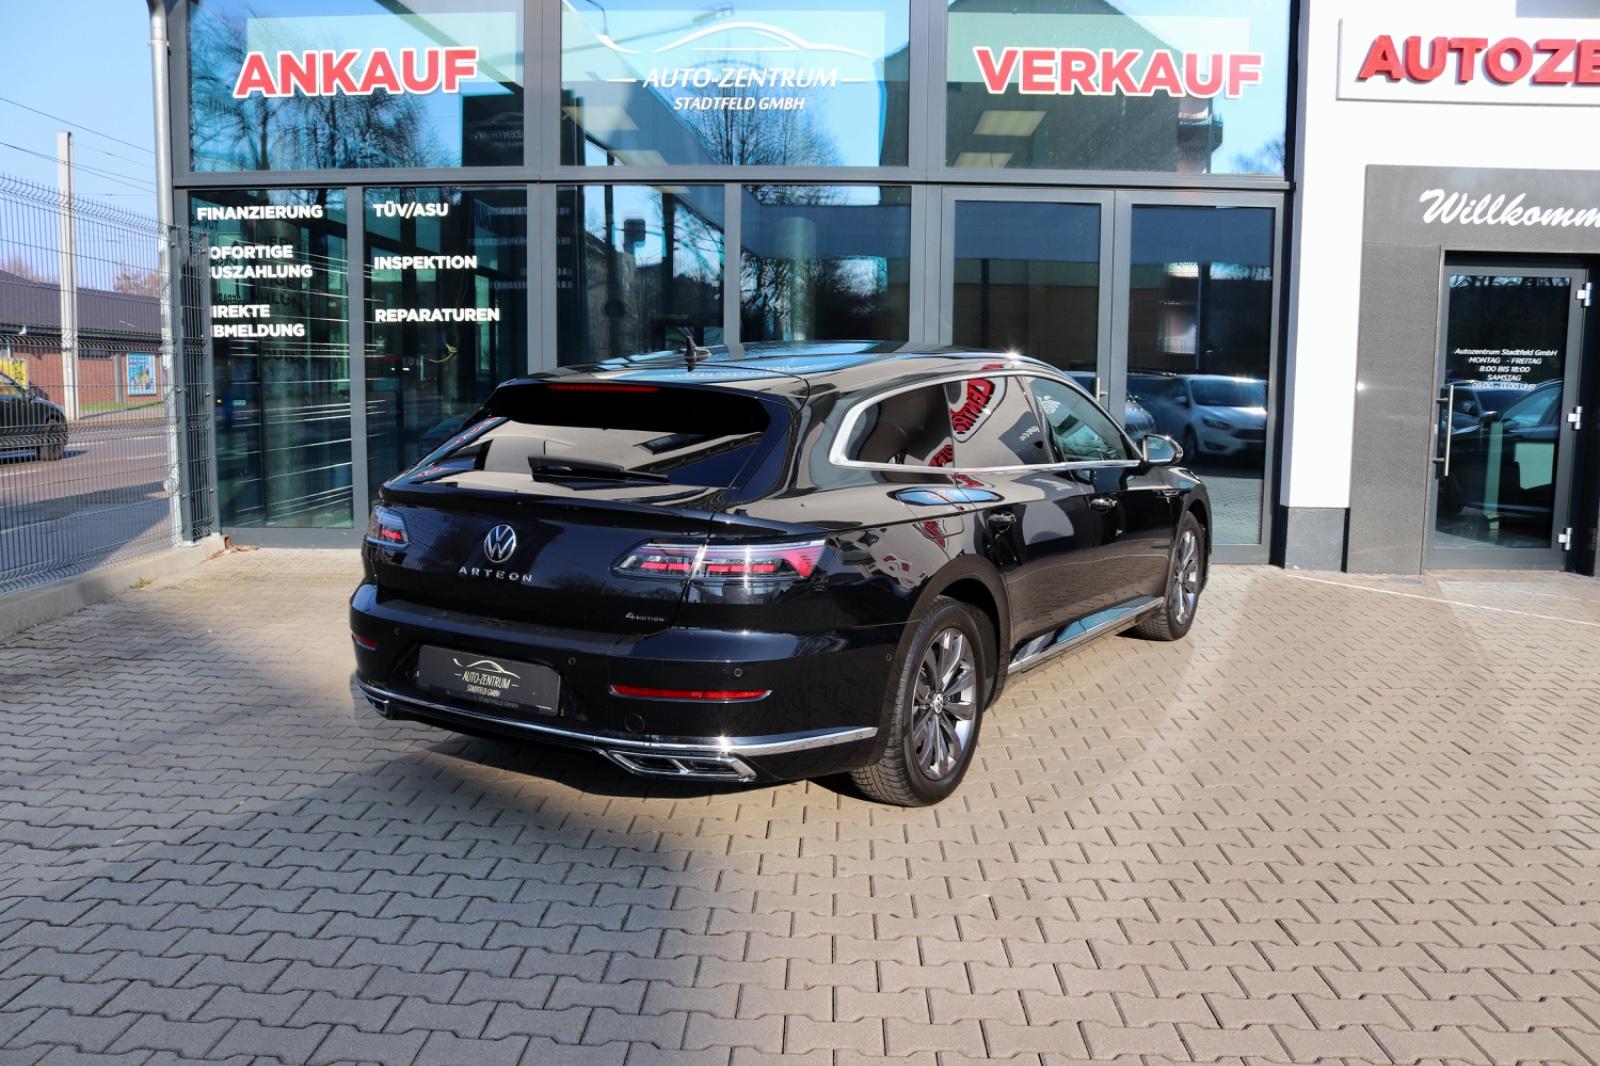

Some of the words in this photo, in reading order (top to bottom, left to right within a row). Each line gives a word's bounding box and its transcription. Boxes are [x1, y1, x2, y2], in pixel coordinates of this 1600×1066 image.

[232, 46, 479, 98] ANKAUF
[642, 67, 838, 89] AUTO-ZENTRUM
[972, 46, 1264, 99] VERKAUF
[673, 97, 755, 110] STADTFELD
[758, 97, 805, 110] GMBH
[197, 204, 324, 221] FINANZIERUNG
[373, 201, 449, 218] TÜV/ASU
[209, 244, 294, 260] OFORTIGE
[373, 255, 478, 271] INSPEKTION
[209, 264, 313, 279] USZAHLUNG
[210, 304, 271, 318] IREKTE
[374, 307, 501, 323] REPARATUREN
[210, 323, 305, 338] BMELDUNG
[458, 565, 533, 583] ARTEON
[462, 670, 511, 688] AUTO-ZENTRUM
